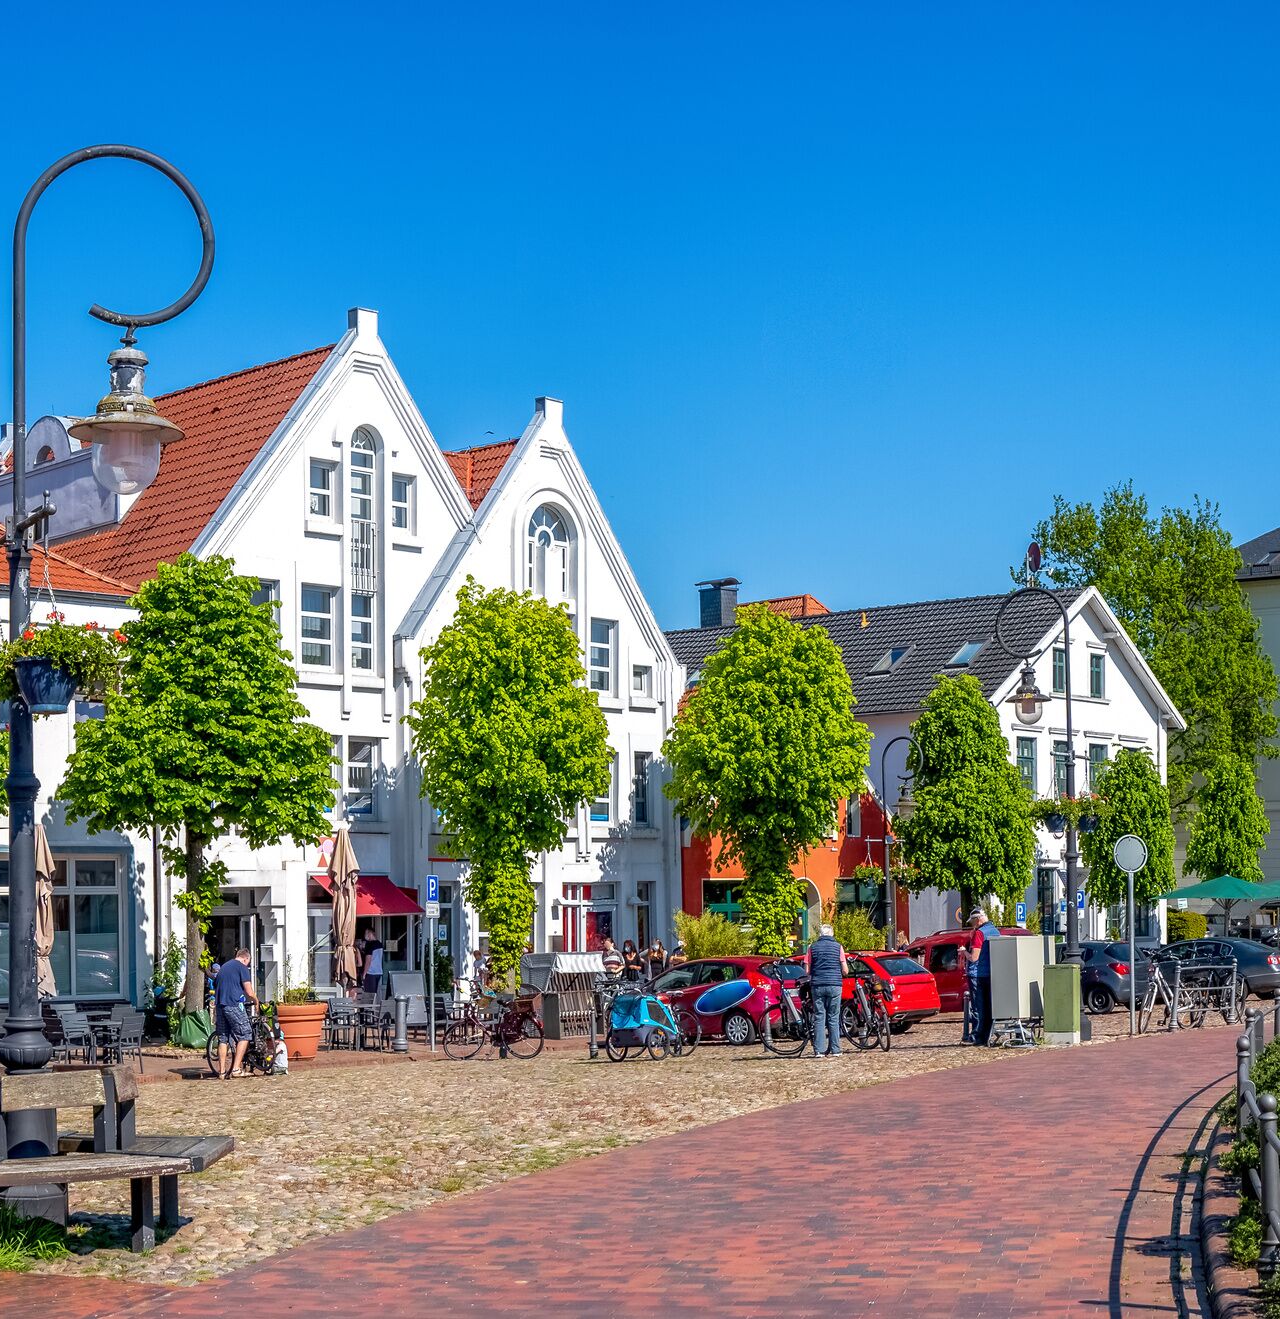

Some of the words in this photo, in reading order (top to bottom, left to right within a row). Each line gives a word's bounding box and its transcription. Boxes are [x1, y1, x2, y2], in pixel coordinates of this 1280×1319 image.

[429, 879, 436, 898] P
[1077, 893, 1083, 906] P
[1018, 905, 1024, 919] P
